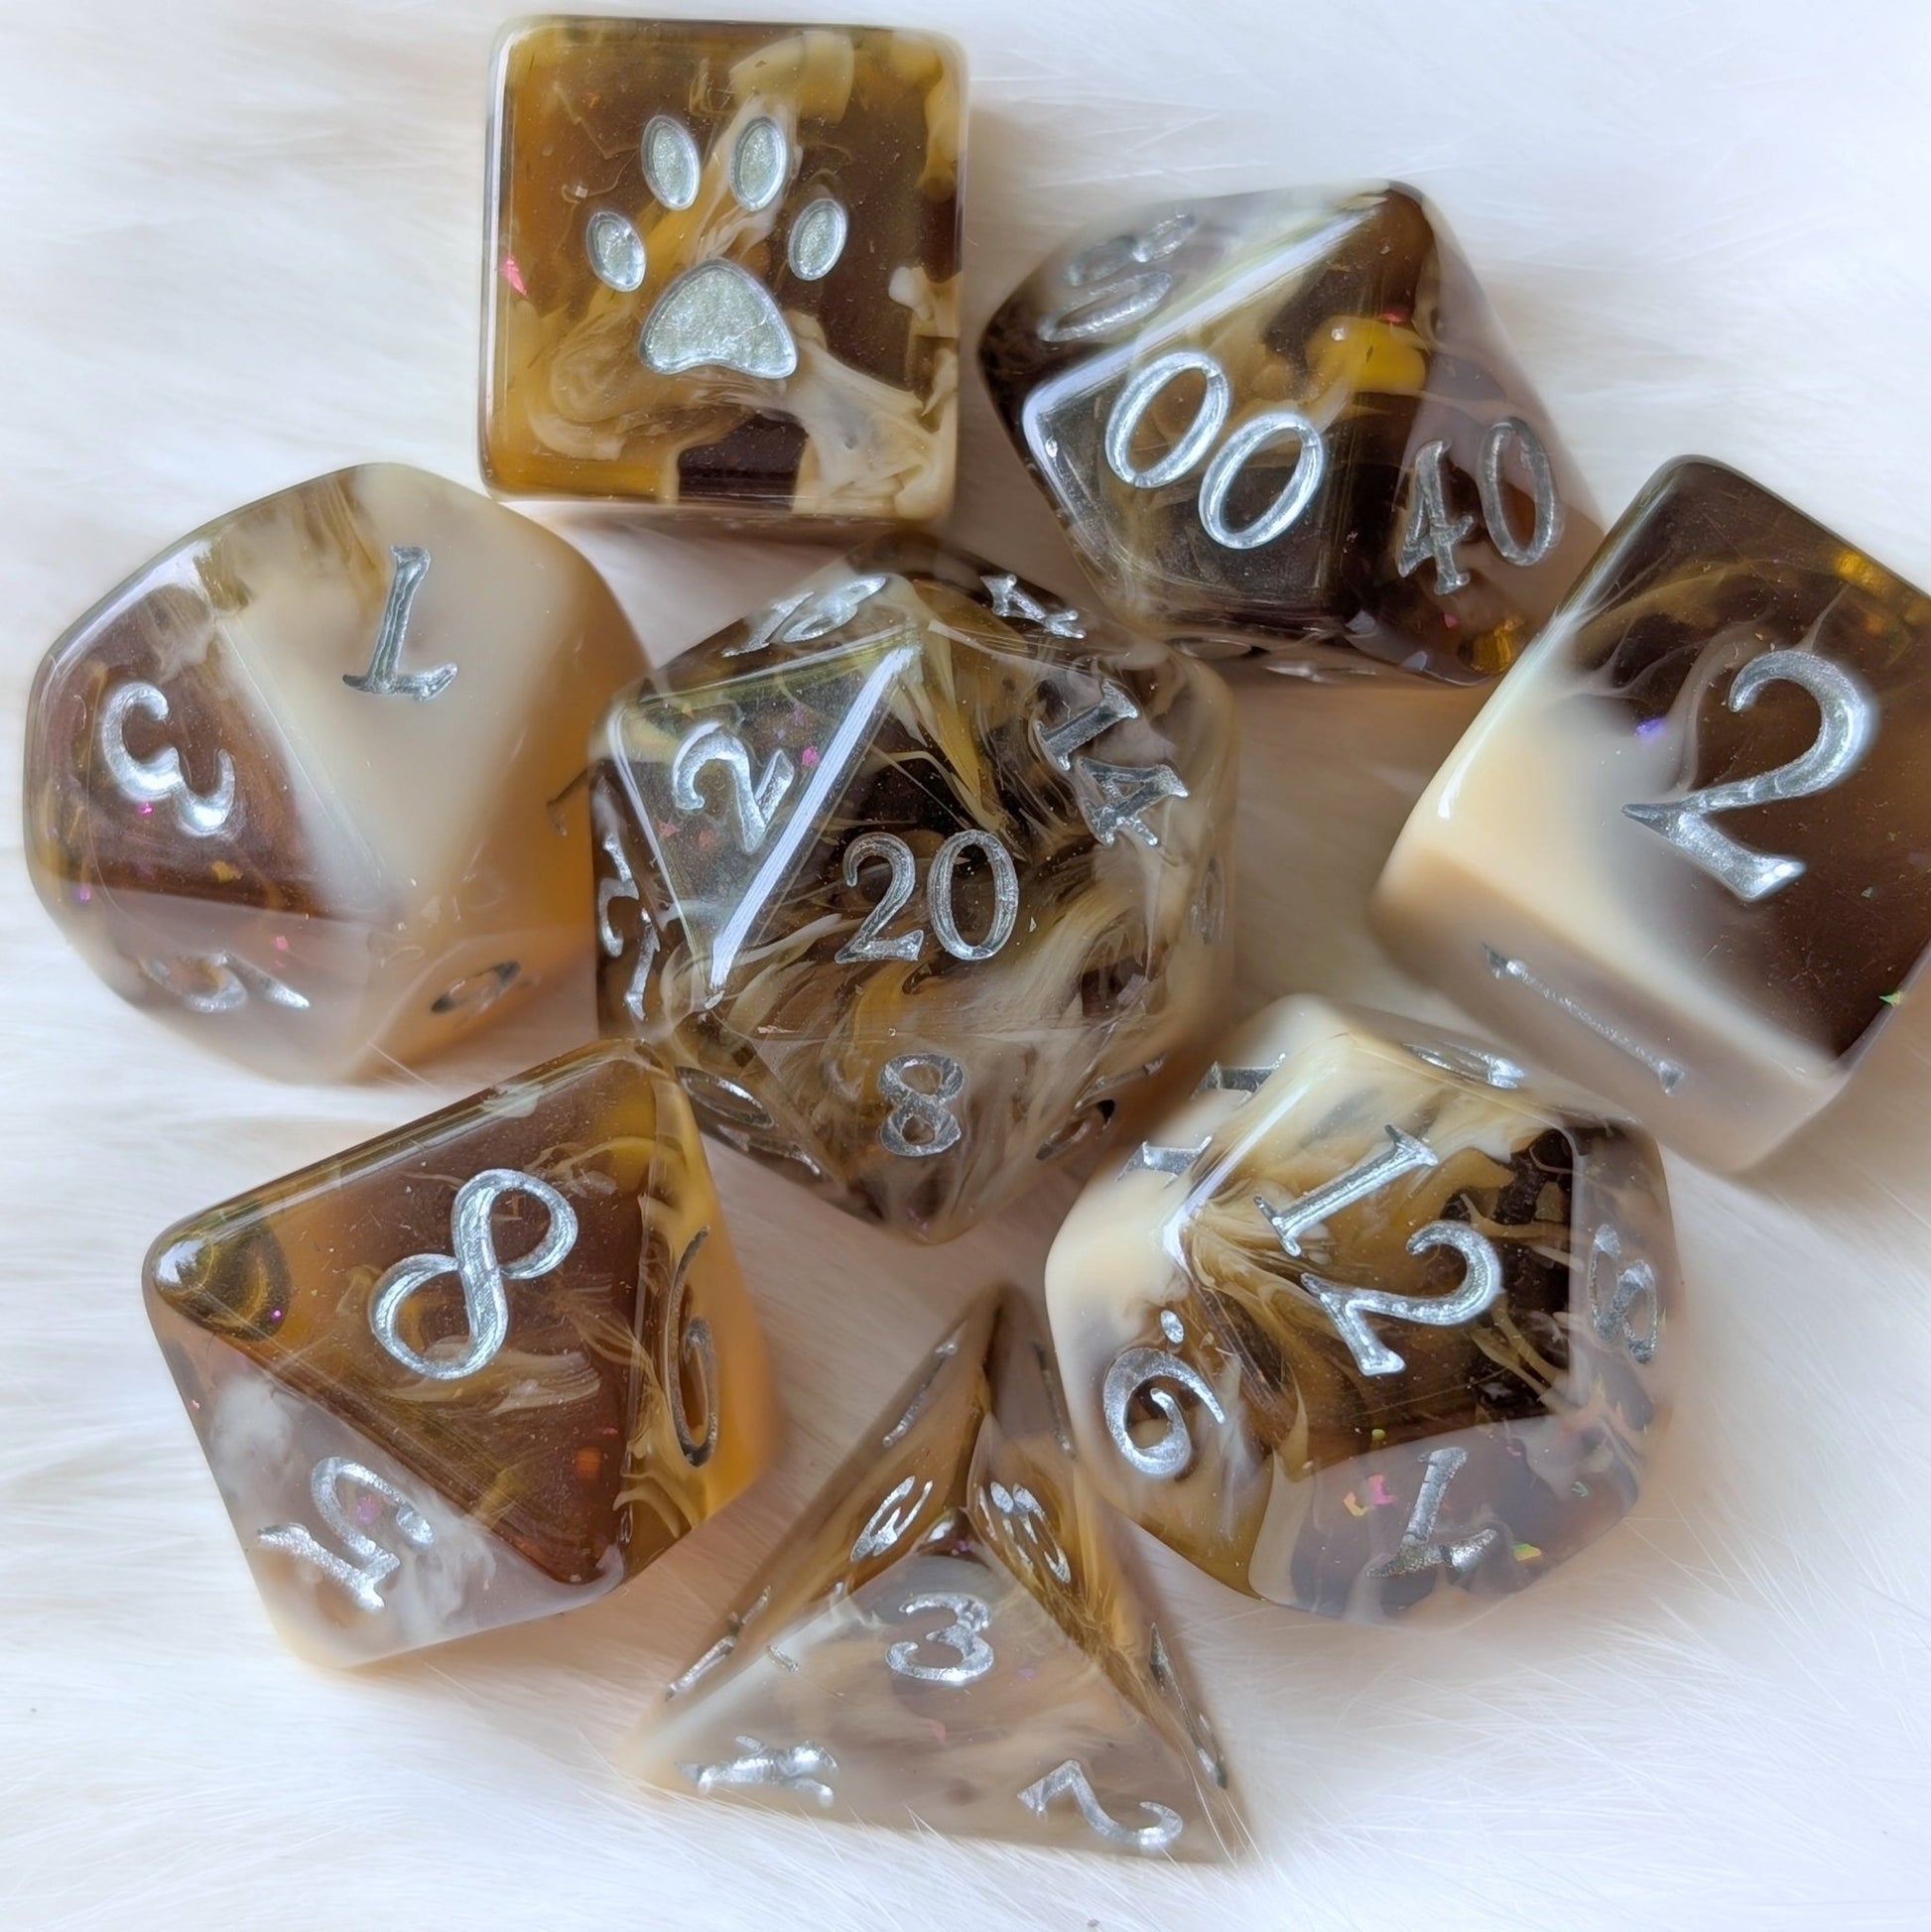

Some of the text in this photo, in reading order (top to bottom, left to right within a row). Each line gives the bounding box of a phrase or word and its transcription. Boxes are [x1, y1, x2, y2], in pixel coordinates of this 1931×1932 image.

[1104, 351, 1326, 550] 00
[1397, 416, 1564, 595] 40
[721, 576, 886, 658] 18
[101, 681, 236, 838] 3
[672, 721, 795, 854] 2
[1032, 679, 1189, 845] 14
[1622, 648, 1872, 901] 2
[835, 829, 1020, 964] 20
[877, 1053, 966, 1157] 8
[369, 1168, 579, 1380] 8
[1253, 1124, 1501, 1376] 12
[256, 1457, 434, 1611] 5
[884, 1592, 994, 1682] 3
[1018, 1760, 1184, 1851] 2
